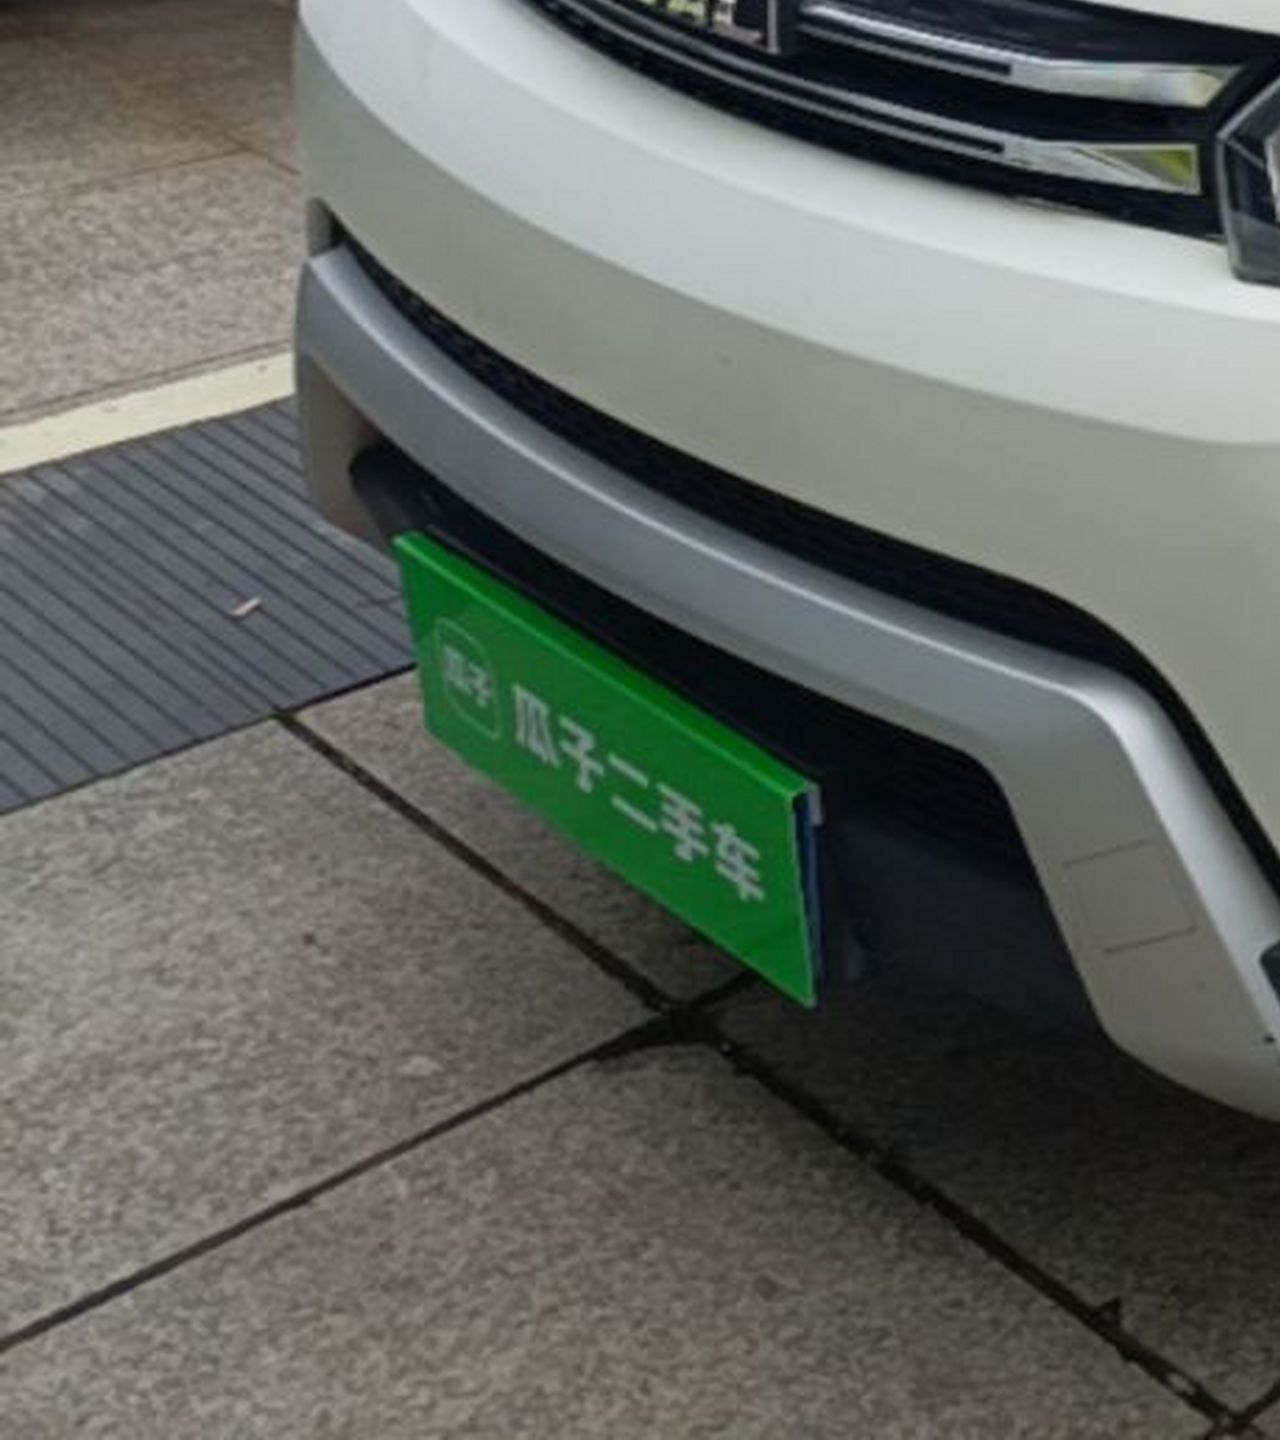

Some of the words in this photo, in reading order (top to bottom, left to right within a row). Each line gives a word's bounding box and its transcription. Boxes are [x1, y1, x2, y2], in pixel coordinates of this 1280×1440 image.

[511, 681, 767, 904] 瓜子二手车
